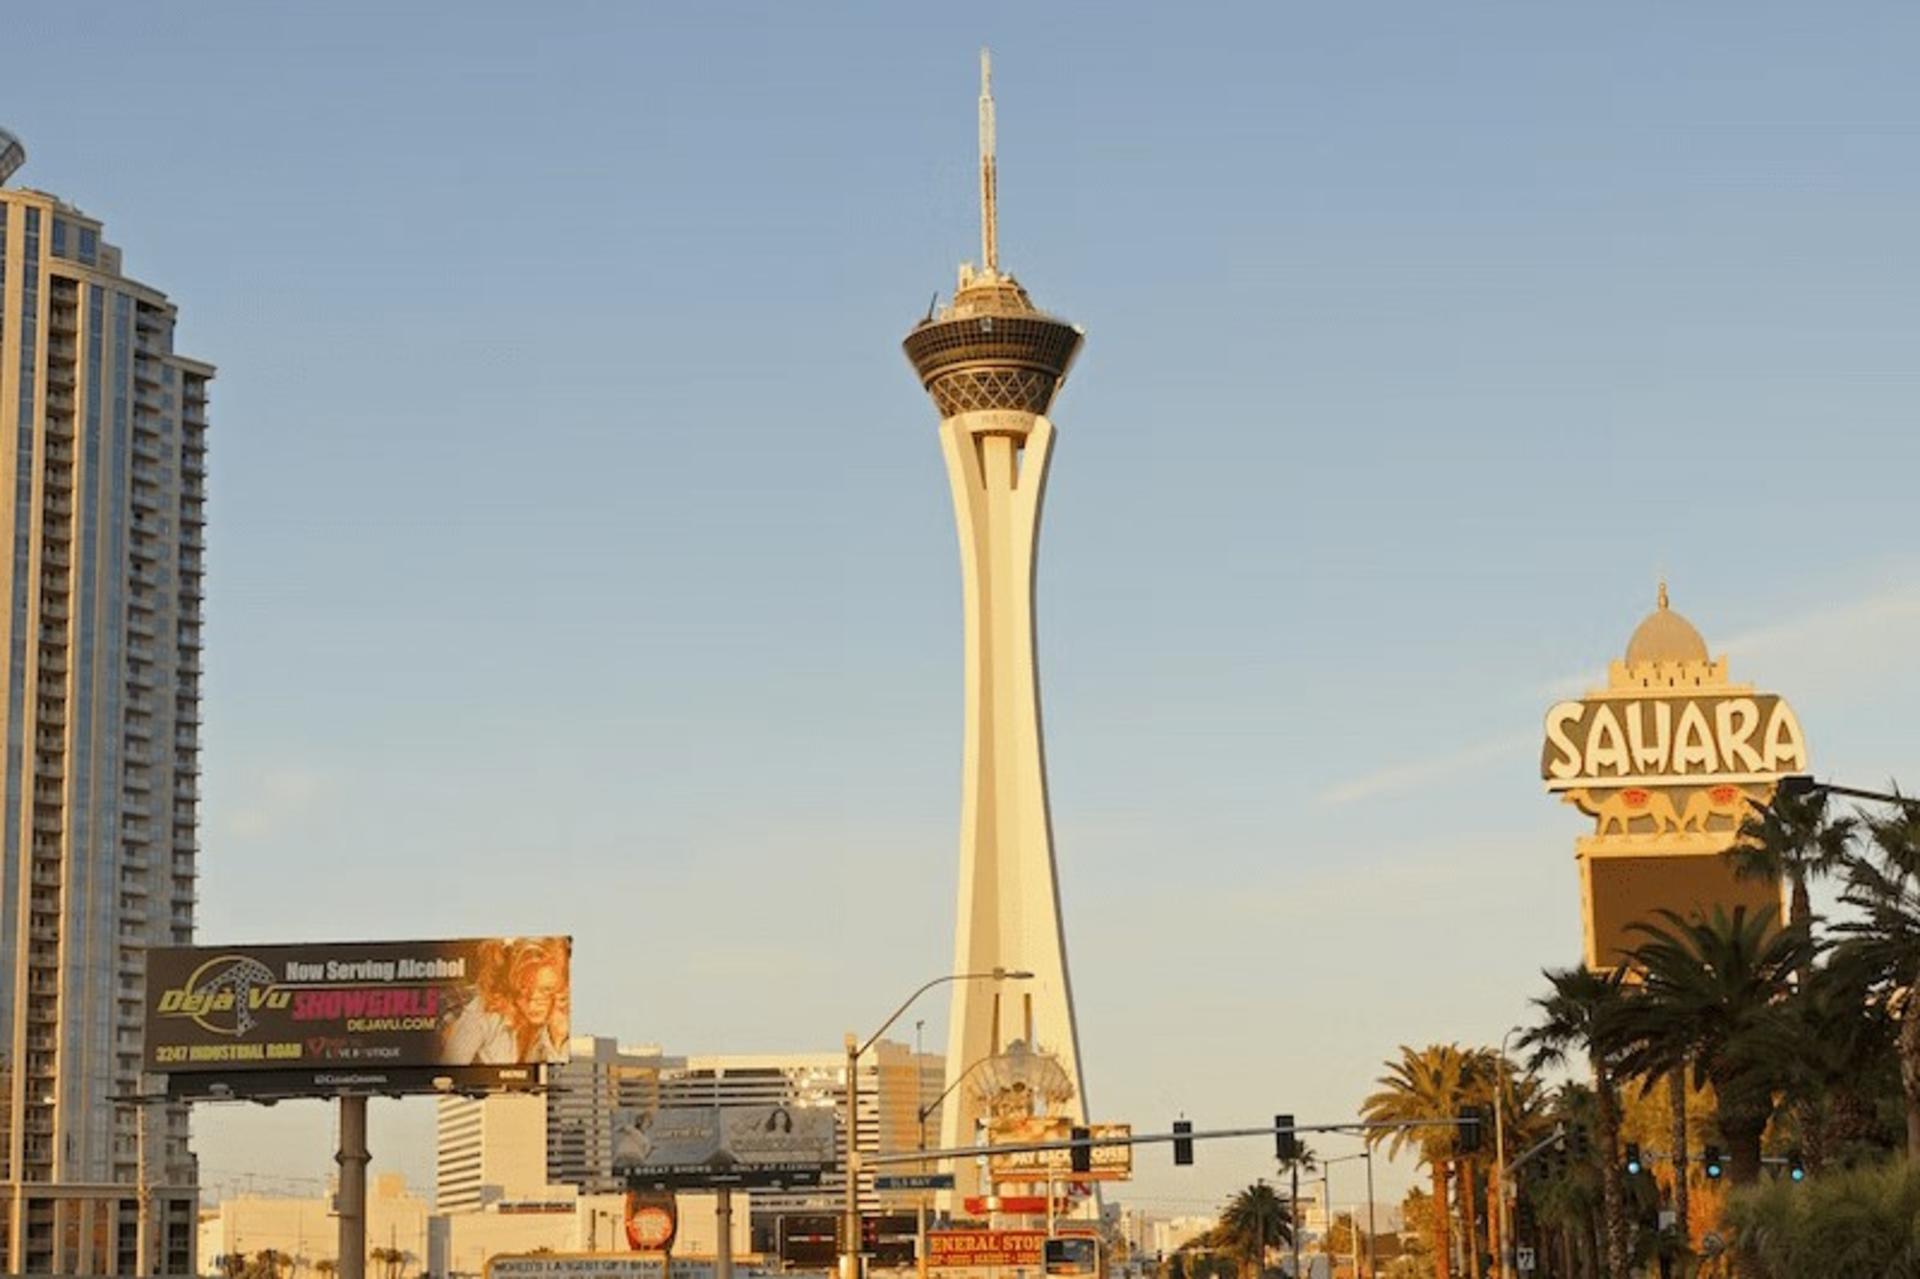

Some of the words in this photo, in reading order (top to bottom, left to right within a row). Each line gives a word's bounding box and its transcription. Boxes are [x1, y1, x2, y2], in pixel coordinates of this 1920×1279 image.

[1546, 698, 1805, 779] SAHARA
[286, 961, 324, 981] Now
[326, 959, 395, 982] Serving
[398, 958, 465, 978] Alcohol
[347, 1017, 437, 1032] DEJAVU.COM
[189, 1044, 264, 1061] INDUSTRIAL
[931, 1235, 999, 1251] ENERAL
